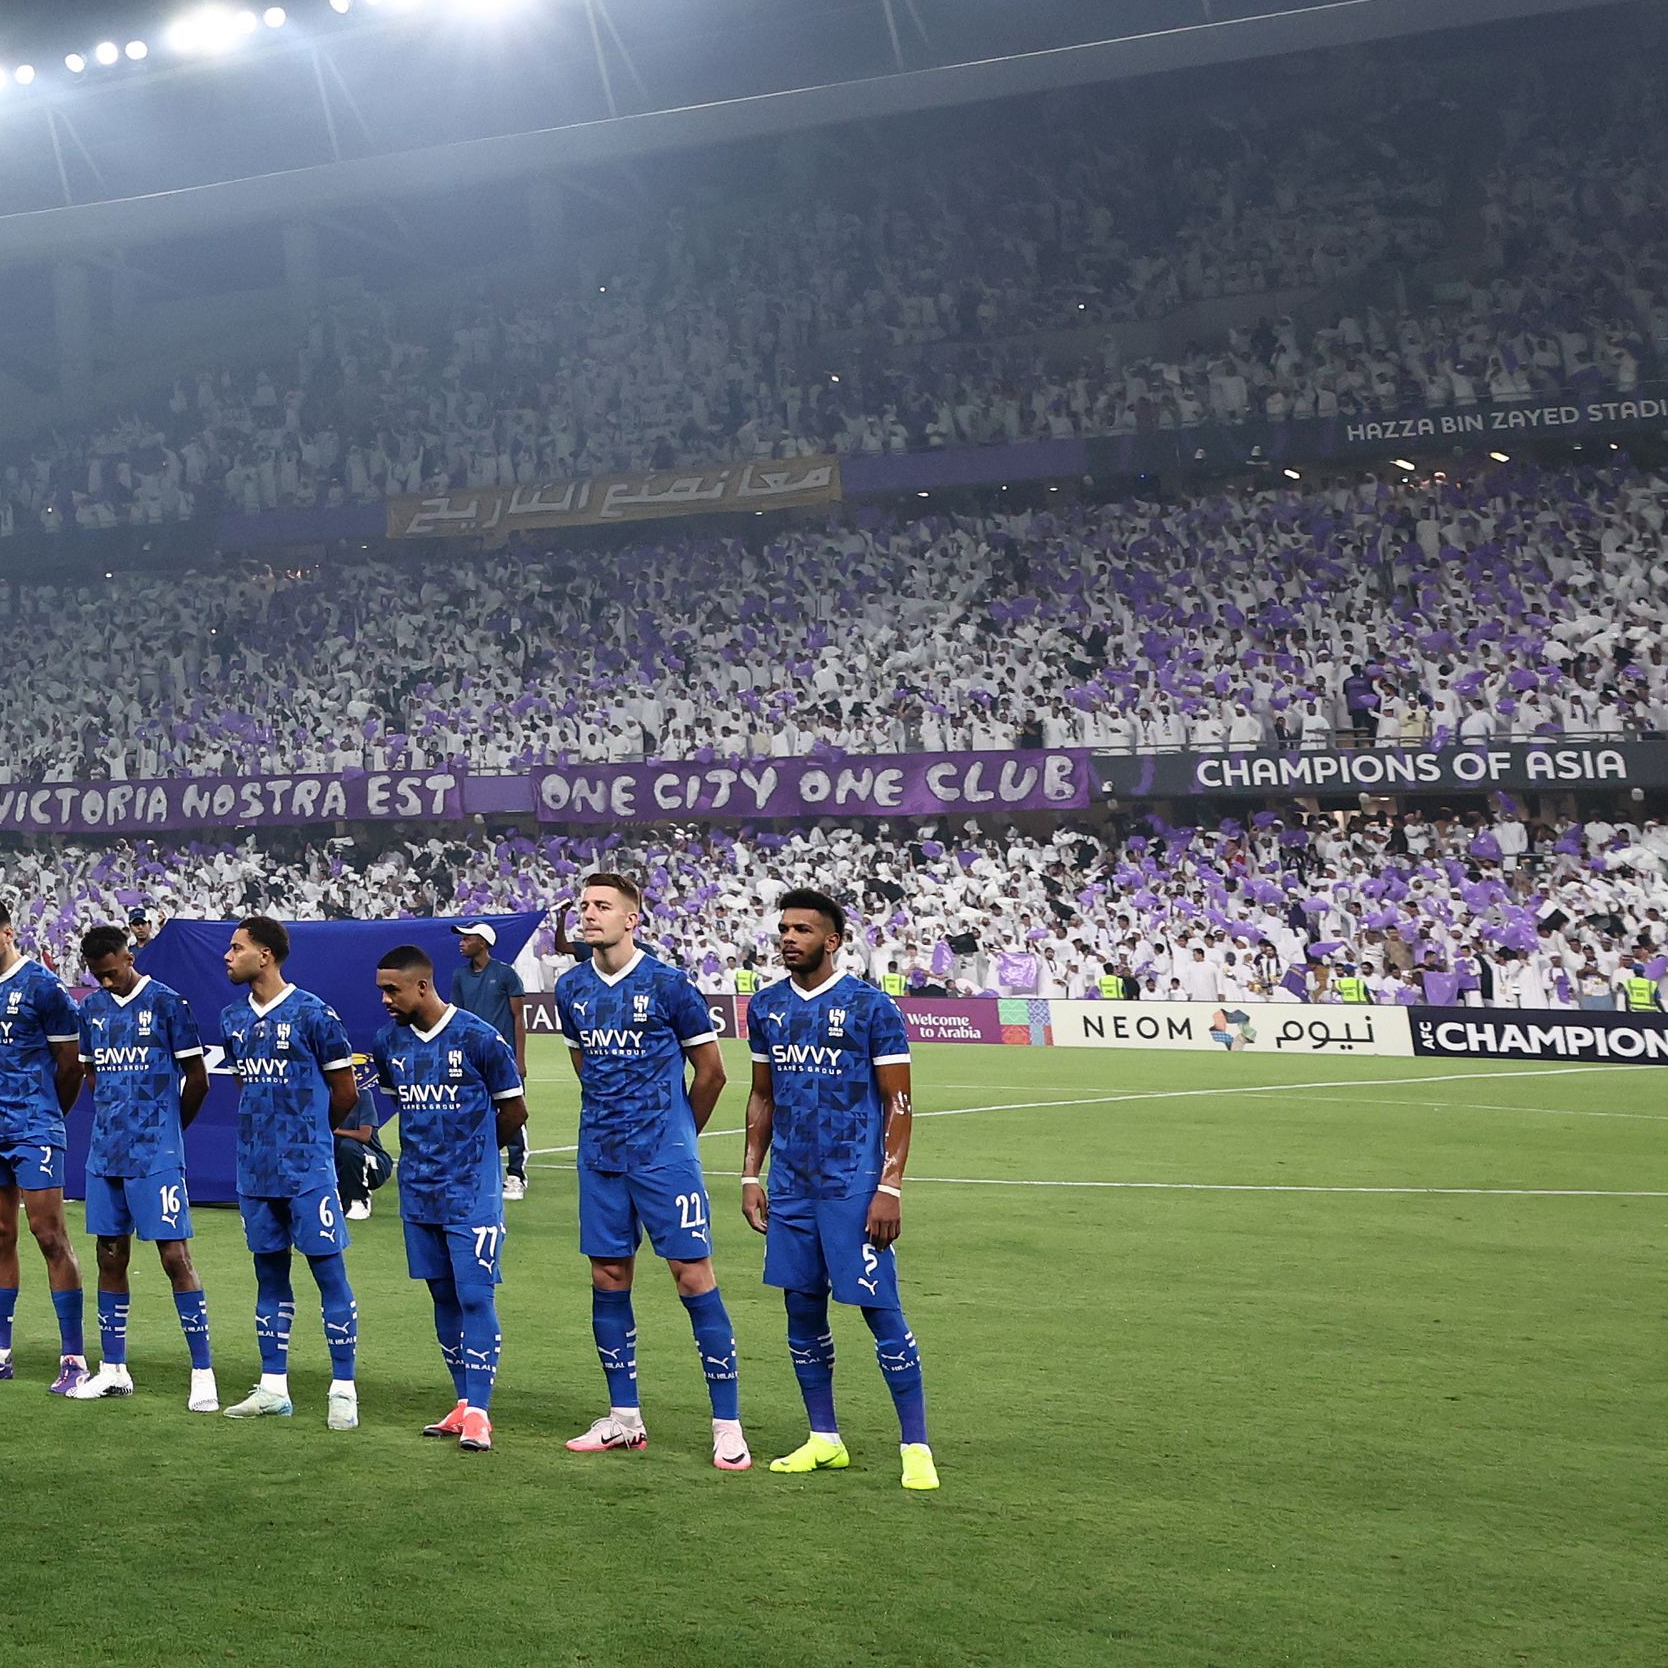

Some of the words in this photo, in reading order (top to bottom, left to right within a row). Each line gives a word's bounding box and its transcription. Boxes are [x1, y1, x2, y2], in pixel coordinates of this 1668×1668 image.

[1347, 417, 1434, 441] HAZZA
[1441, 414, 1484, 434] BIN
[1491, 407, 1579, 431] ZAYED
[1196, 752, 1441, 788] CHAMPIONS
[1453, 750, 1511, 782] OF
[1526, 749, 1628, 780] ASIA
[182, 779, 347, 820] NOSTRA
[367, 773, 456, 816] EST
[540, 773, 636, 817] ONE
[653, 765, 777, 809] CITY
[799, 767, 903, 807] ONE
[926, 754, 1073, 802] CLUB
[907, 1013, 970, 1027] Welcome
[920, 1026, 935, 1039] to
[936, 1025, 982, 1040] Arabia
[1082, 1015, 1193, 1040] NEOM
[1276, 1015, 1375, 1050] نيوم
[579, 1028, 644, 1048] SAVVY
[1421, 1021, 1437, 1050] AFC
[94, 1046, 149, 1065] SAVVY
[771, 1044, 842, 1066] SAVVY
[807, 1065, 843, 1075] GROUP
[398, 1084, 459, 1102] SAVVY
[159, 1185, 180, 1213] 16
[319, 1195, 334, 1228] 6
[675, 1192, 706, 1229] 22
[471, 1225, 498, 1259] 77
